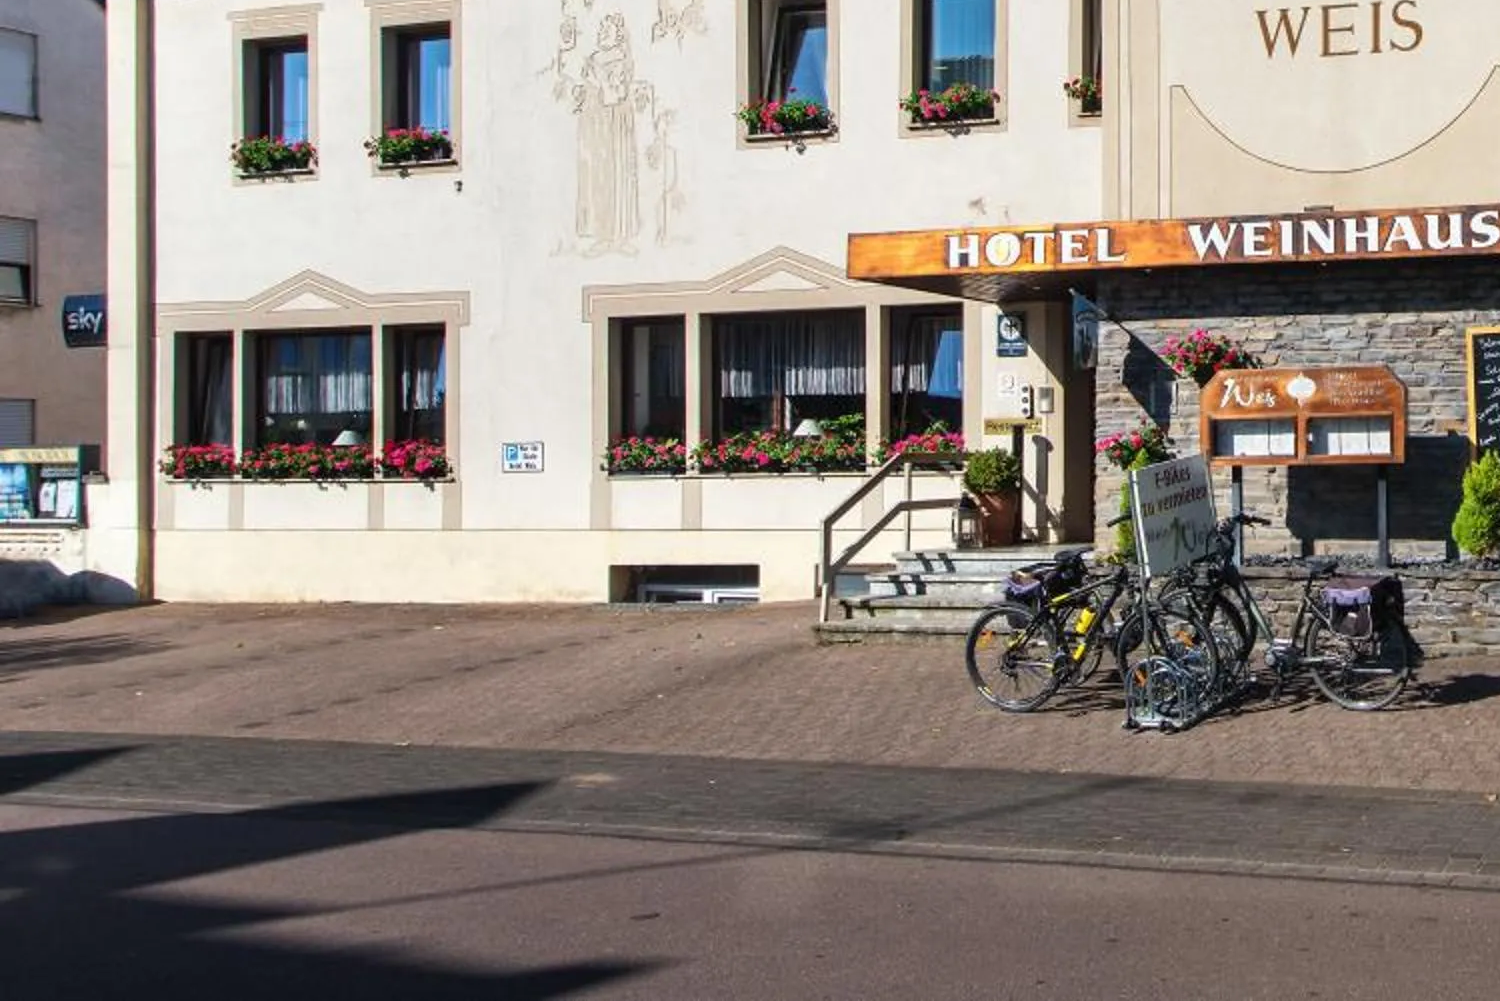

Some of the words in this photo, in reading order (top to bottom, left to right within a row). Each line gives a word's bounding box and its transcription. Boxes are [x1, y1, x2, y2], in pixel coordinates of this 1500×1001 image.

[1256, 0, 1423, 58] WEIS
[946, 227, 1127, 268] HOTEL
[1187, 209, 1500, 261] WEINHAUS
[67, 306, 104, 335] sky
